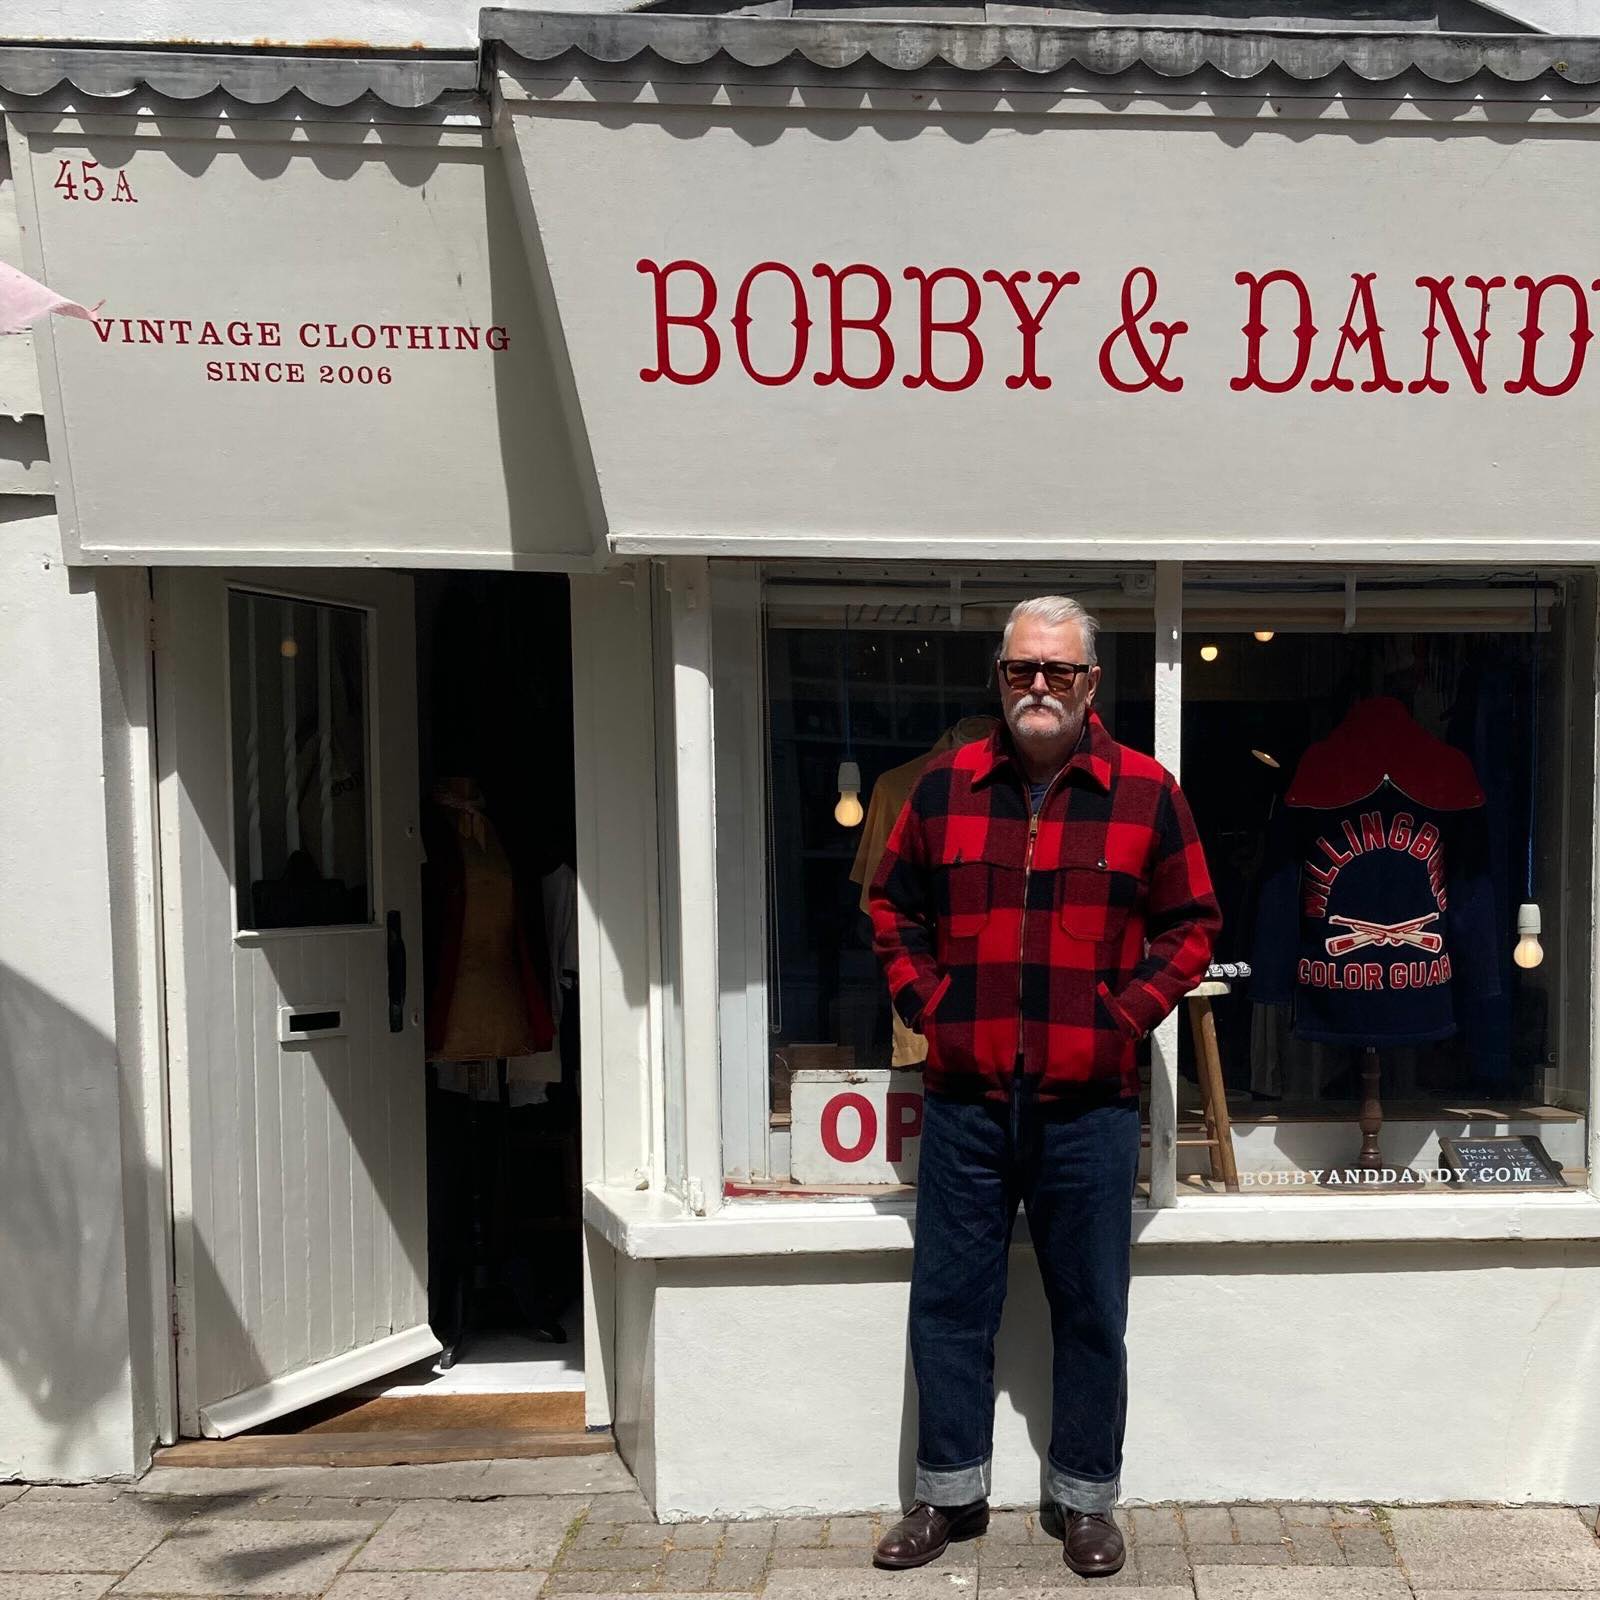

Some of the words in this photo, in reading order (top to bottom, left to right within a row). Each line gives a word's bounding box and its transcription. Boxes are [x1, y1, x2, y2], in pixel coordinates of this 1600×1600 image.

[91, 319, 281, 347] VINTAGE
[299, 323, 511, 351] CLOTHING
[637, 258, 1080, 392] BOBBY
[1099, 267, 1189, 394] &
[1230, 269, 1600, 398] DAND
[206, 361, 305, 383] SINCE
[319, 365, 393, 385] 2006
[1298, 958, 1384, 991] COLOR
[1242, 1167, 1533, 1186] BOBBYANDDANDY.COM
